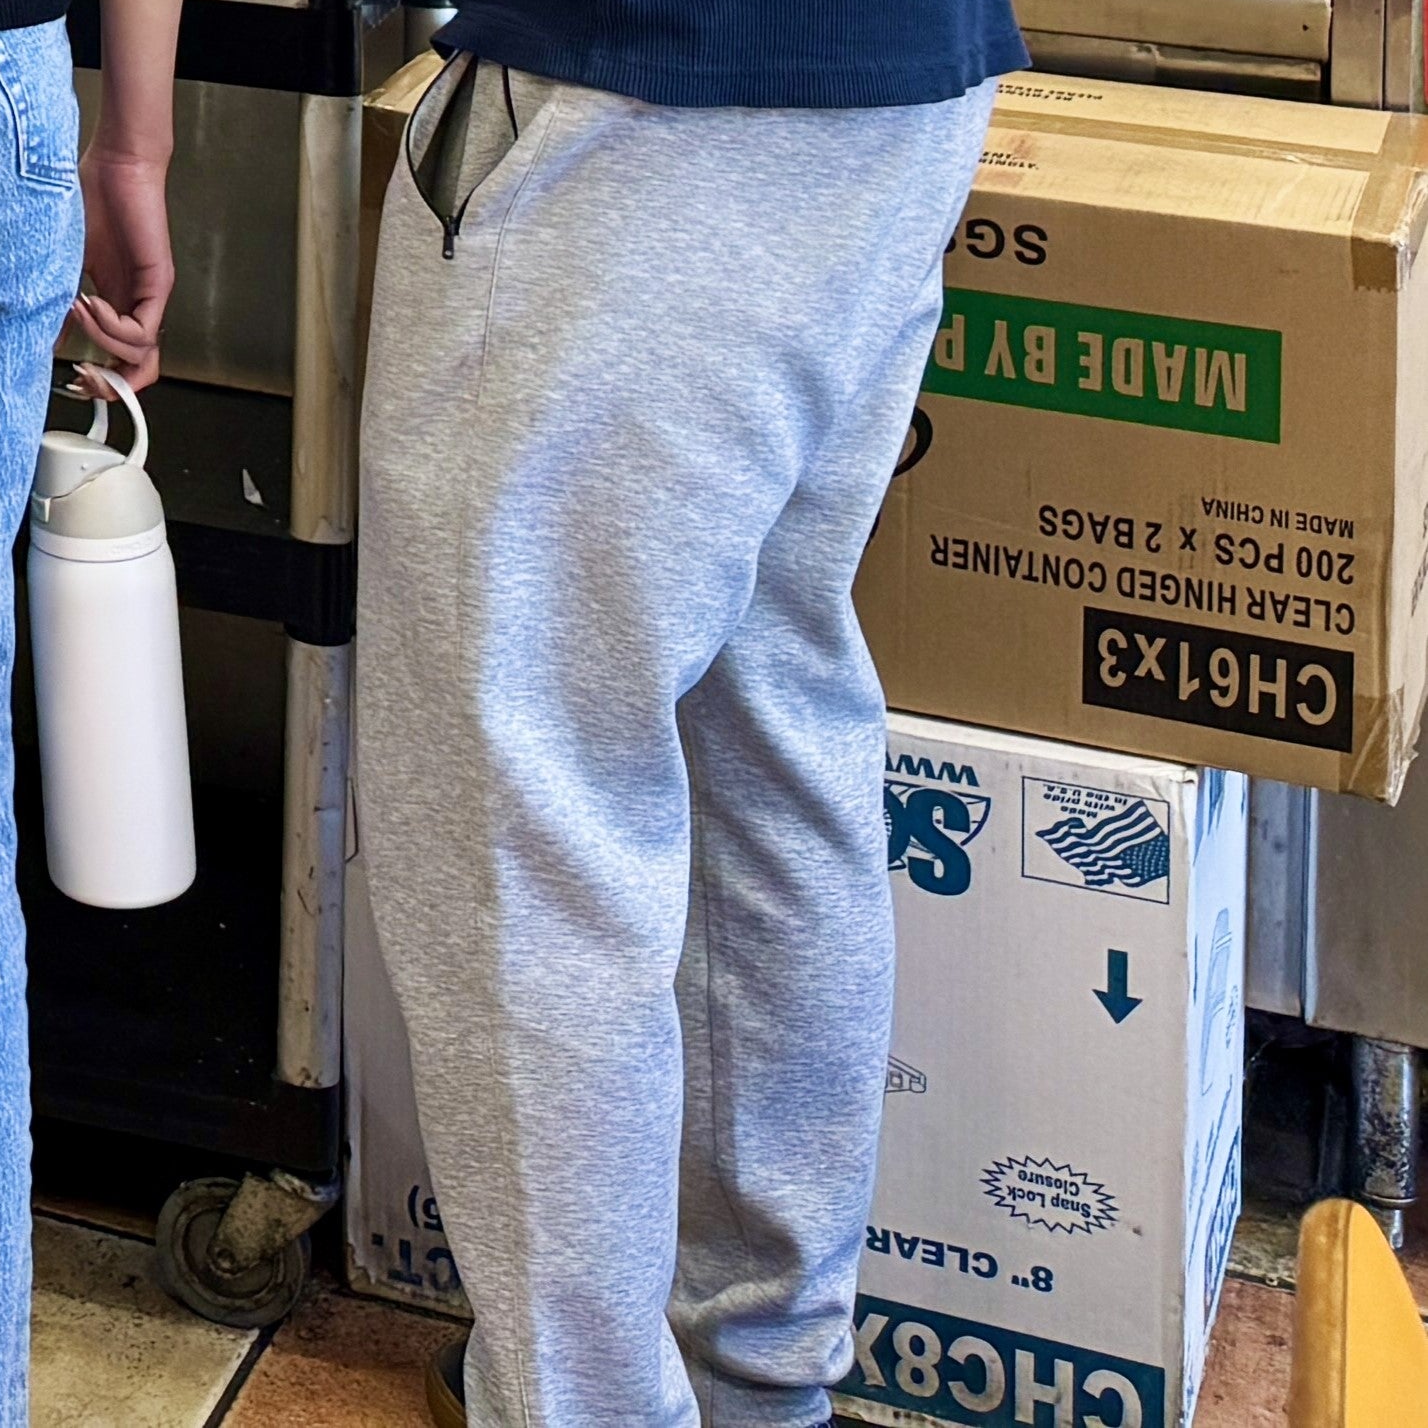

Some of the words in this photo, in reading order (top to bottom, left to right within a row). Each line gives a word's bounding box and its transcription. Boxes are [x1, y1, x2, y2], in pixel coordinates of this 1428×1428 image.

[943, 218, 1048, 265] SG
[985, 319, 1055, 387] BY
[1079, 332, 1247, 412] MADE
[1038, 504, 1134, 549] BAGS
[1201, 496, 1264, 524] CHINA
[1271, 509, 1289, 529] IN
[1297, 512, 1354, 539] MADE
[1145, 522, 1162, 553] 2
[1216, 533, 1284, 574] PCS
[931, 534, 1107, 593] CONTAINER
[1297, 546, 1355, 585] 200
[1117, 567, 1236, 616] HINGED
[1247, 586, 1355, 635] CLEAR
[1098, 627, 1337, 726] CH61x3
[1043, 793, 1080, 805] pride
[1060, 805, 1098, 818] Made
[1084, 800, 1115, 811] with
[1086, 791, 1109, 802] the
[1007, 1185, 1045, 1208] Lock
[1018, 1169, 1080, 1196] Closure
[1051, 1196, 1091, 1219] Snap
[866, 1225, 998, 1278] CLEAR
